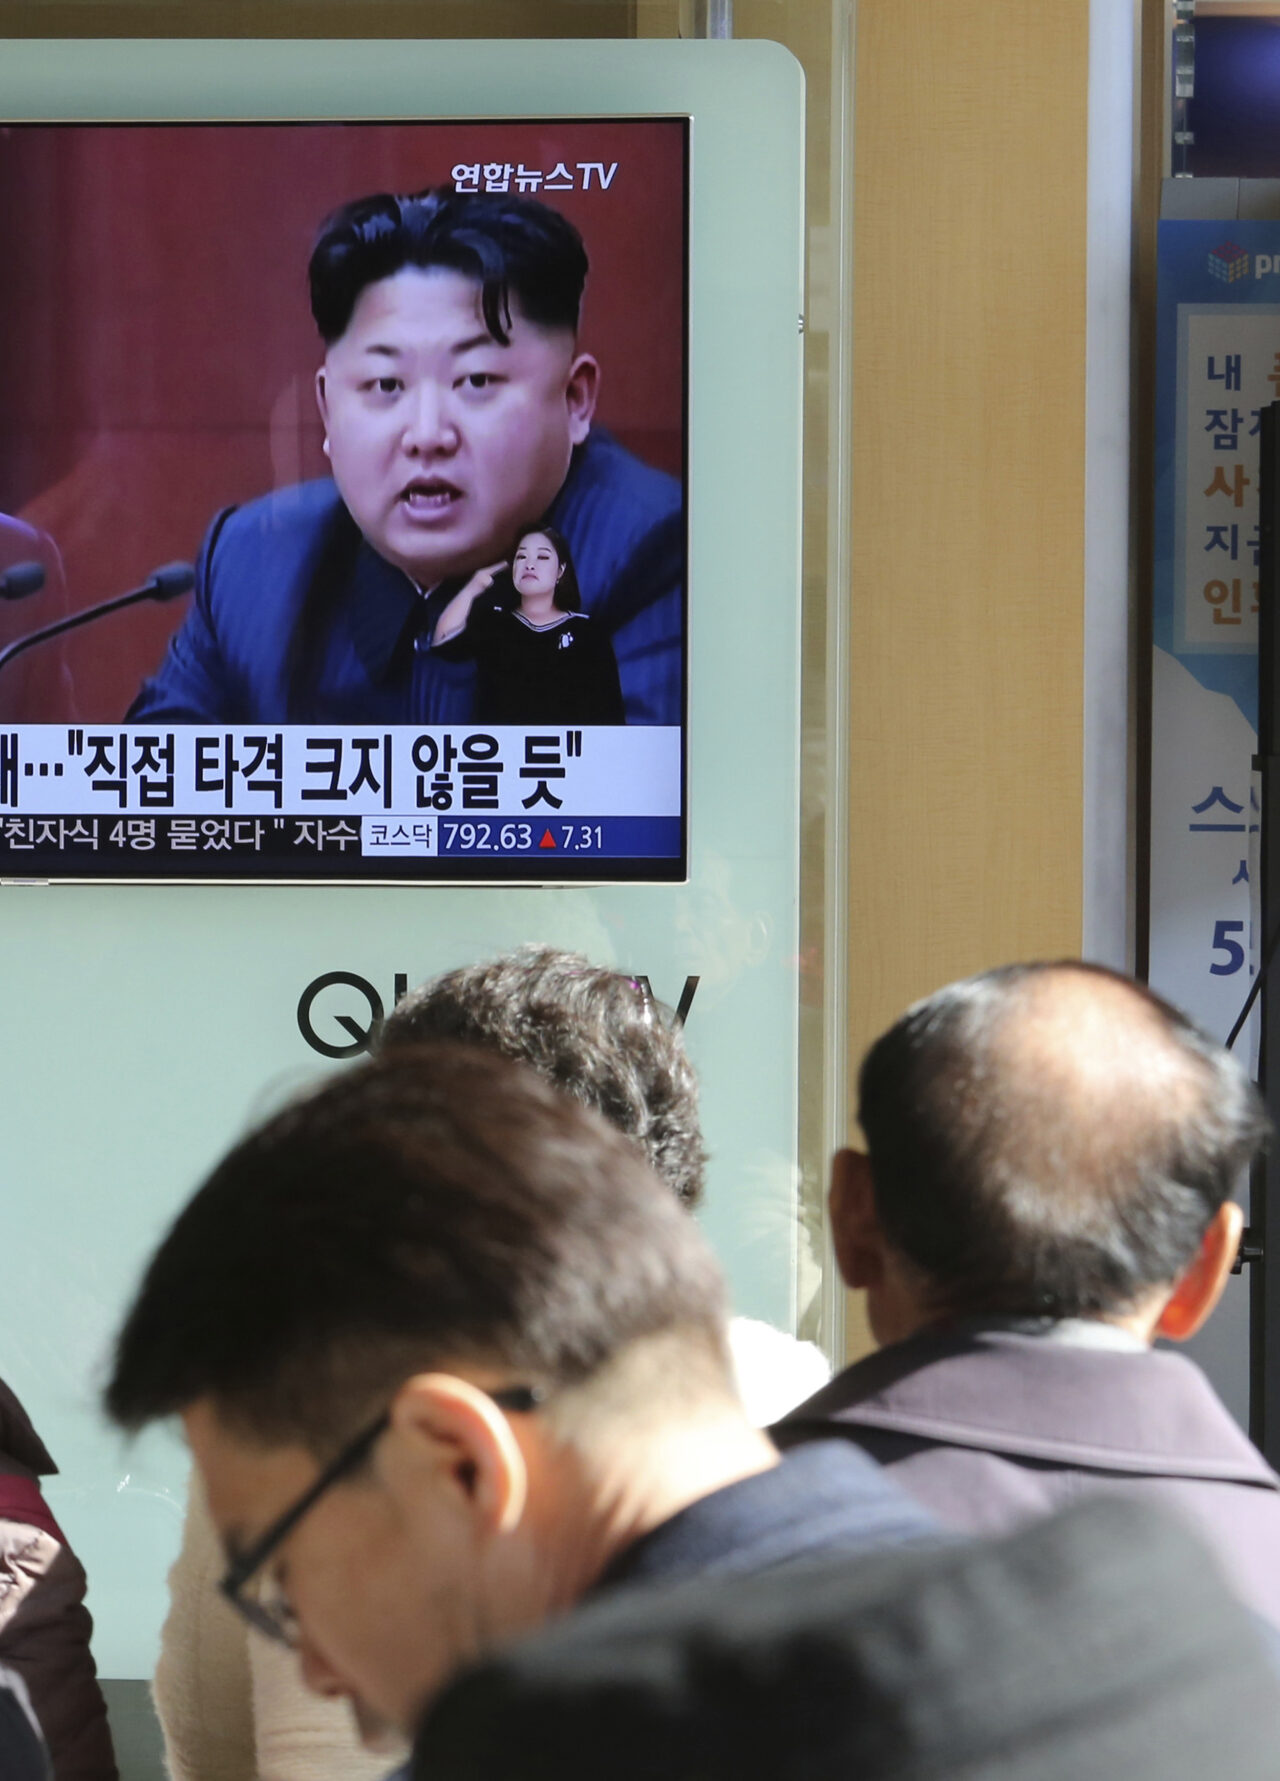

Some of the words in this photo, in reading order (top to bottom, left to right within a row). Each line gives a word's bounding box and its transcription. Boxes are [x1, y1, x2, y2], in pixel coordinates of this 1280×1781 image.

[451, 162, 618, 193] 연합뉴스TV
[1207, 354, 1242, 391] 내
[1203, 464, 1260, 508] 사
[1203, 578, 1260, 625] 인
[195, 733, 284, 809] 타격
[301, 734, 393, 809] 크지
[411, 734, 504, 811] 않을
[519, 731, 582, 810] 듯"
[109, 818, 157, 850] 4명
[293, 818, 359, 851] 자수
[369, 823, 433, 849] 코스닥
[443, 822, 532, 851] 792.63
[561, 825, 603, 852] 7.31
